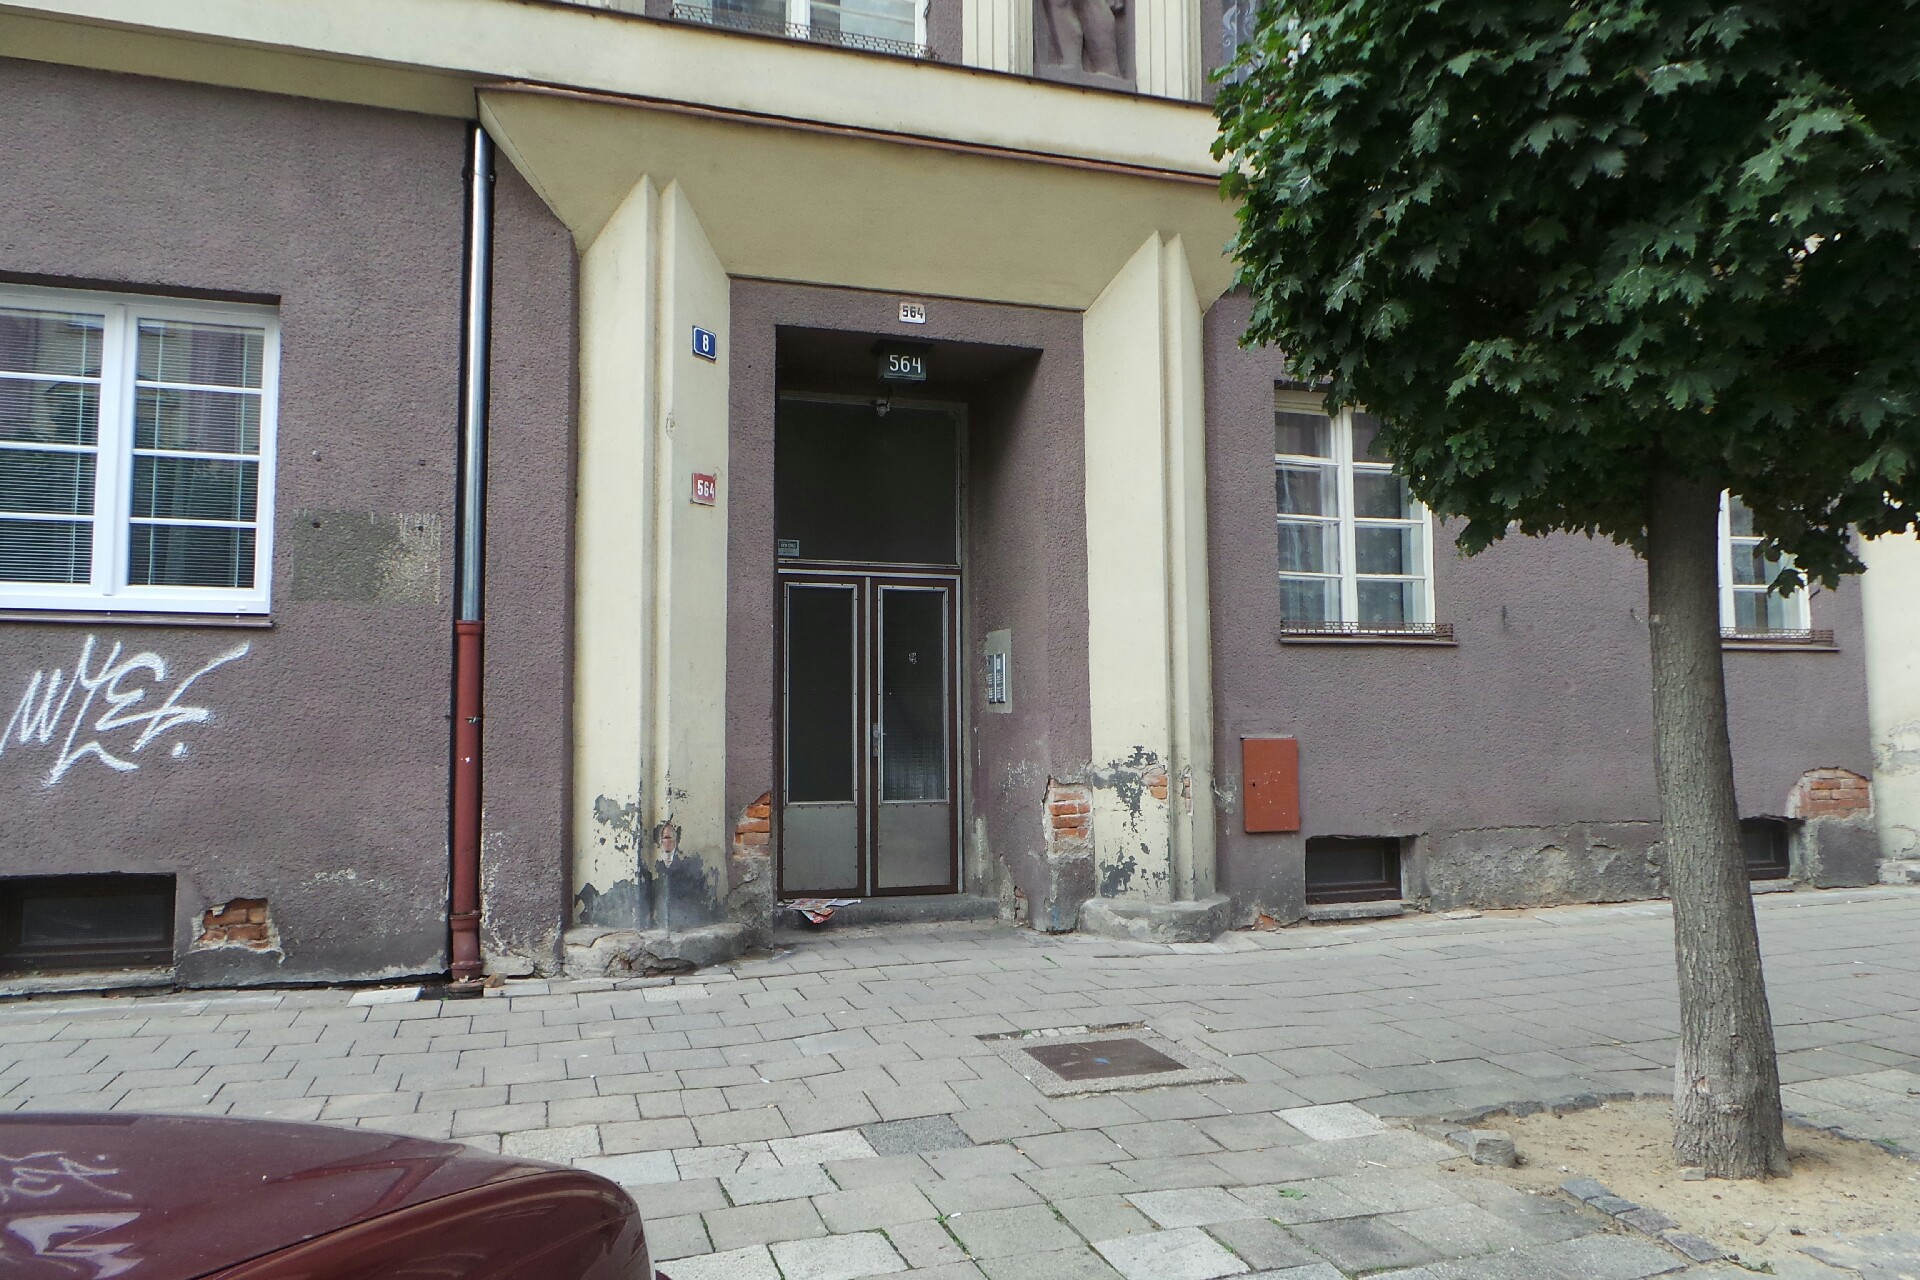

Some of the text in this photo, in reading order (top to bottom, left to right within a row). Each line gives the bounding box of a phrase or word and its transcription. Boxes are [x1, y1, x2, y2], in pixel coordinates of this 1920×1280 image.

[902, 305, 924, 319] 564
[702, 334, 709, 352] 8
[889, 354, 921, 374] 564
[697, 479, 715, 499] 564
